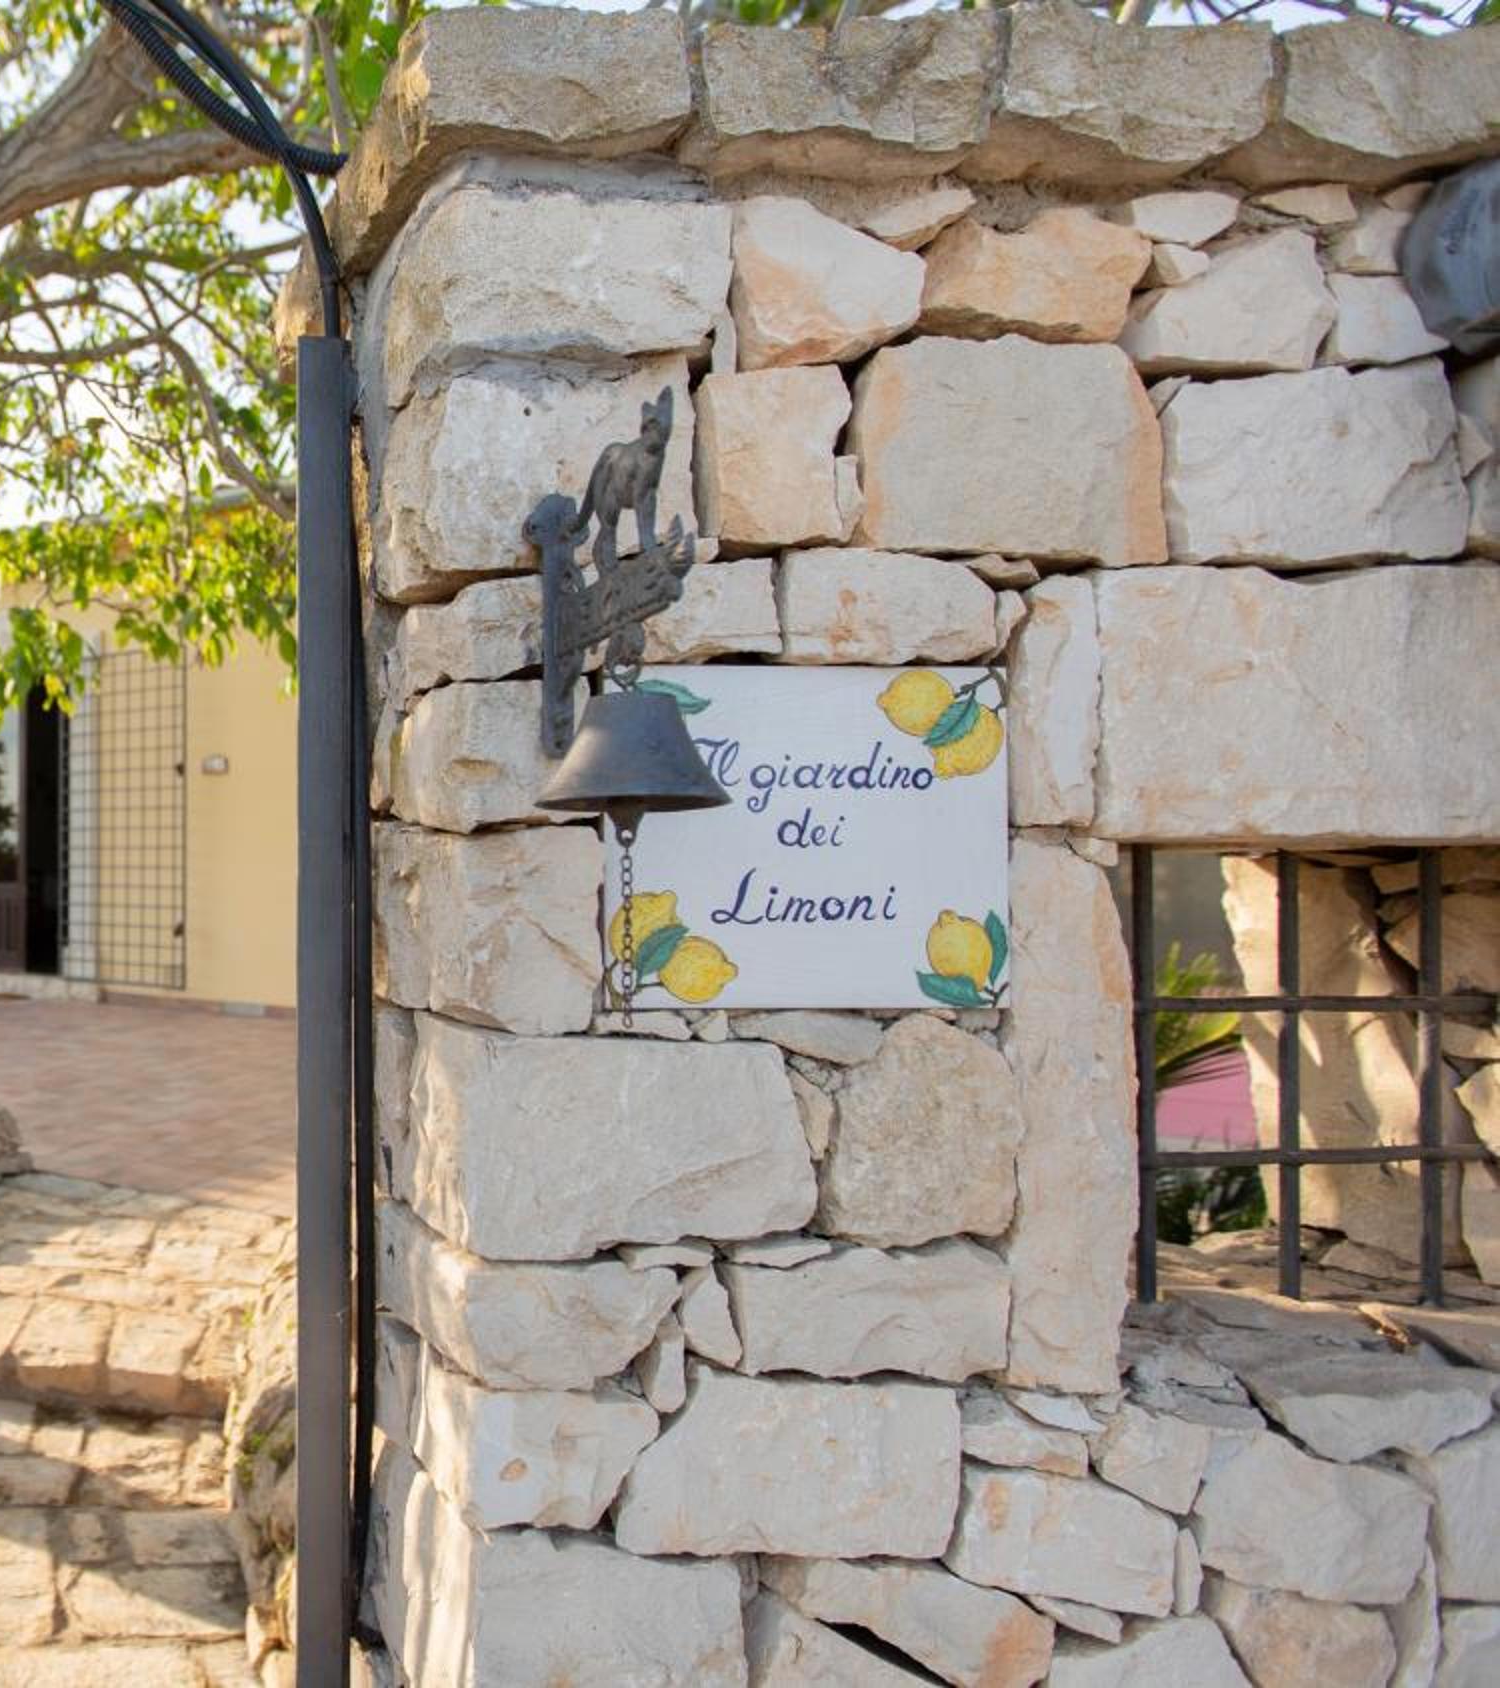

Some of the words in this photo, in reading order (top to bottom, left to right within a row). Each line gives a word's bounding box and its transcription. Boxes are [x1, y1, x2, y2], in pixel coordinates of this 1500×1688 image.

[748, 741, 934, 813] giardino
[777, 808, 845, 848] dei
[711, 868, 897, 925] Limoni
